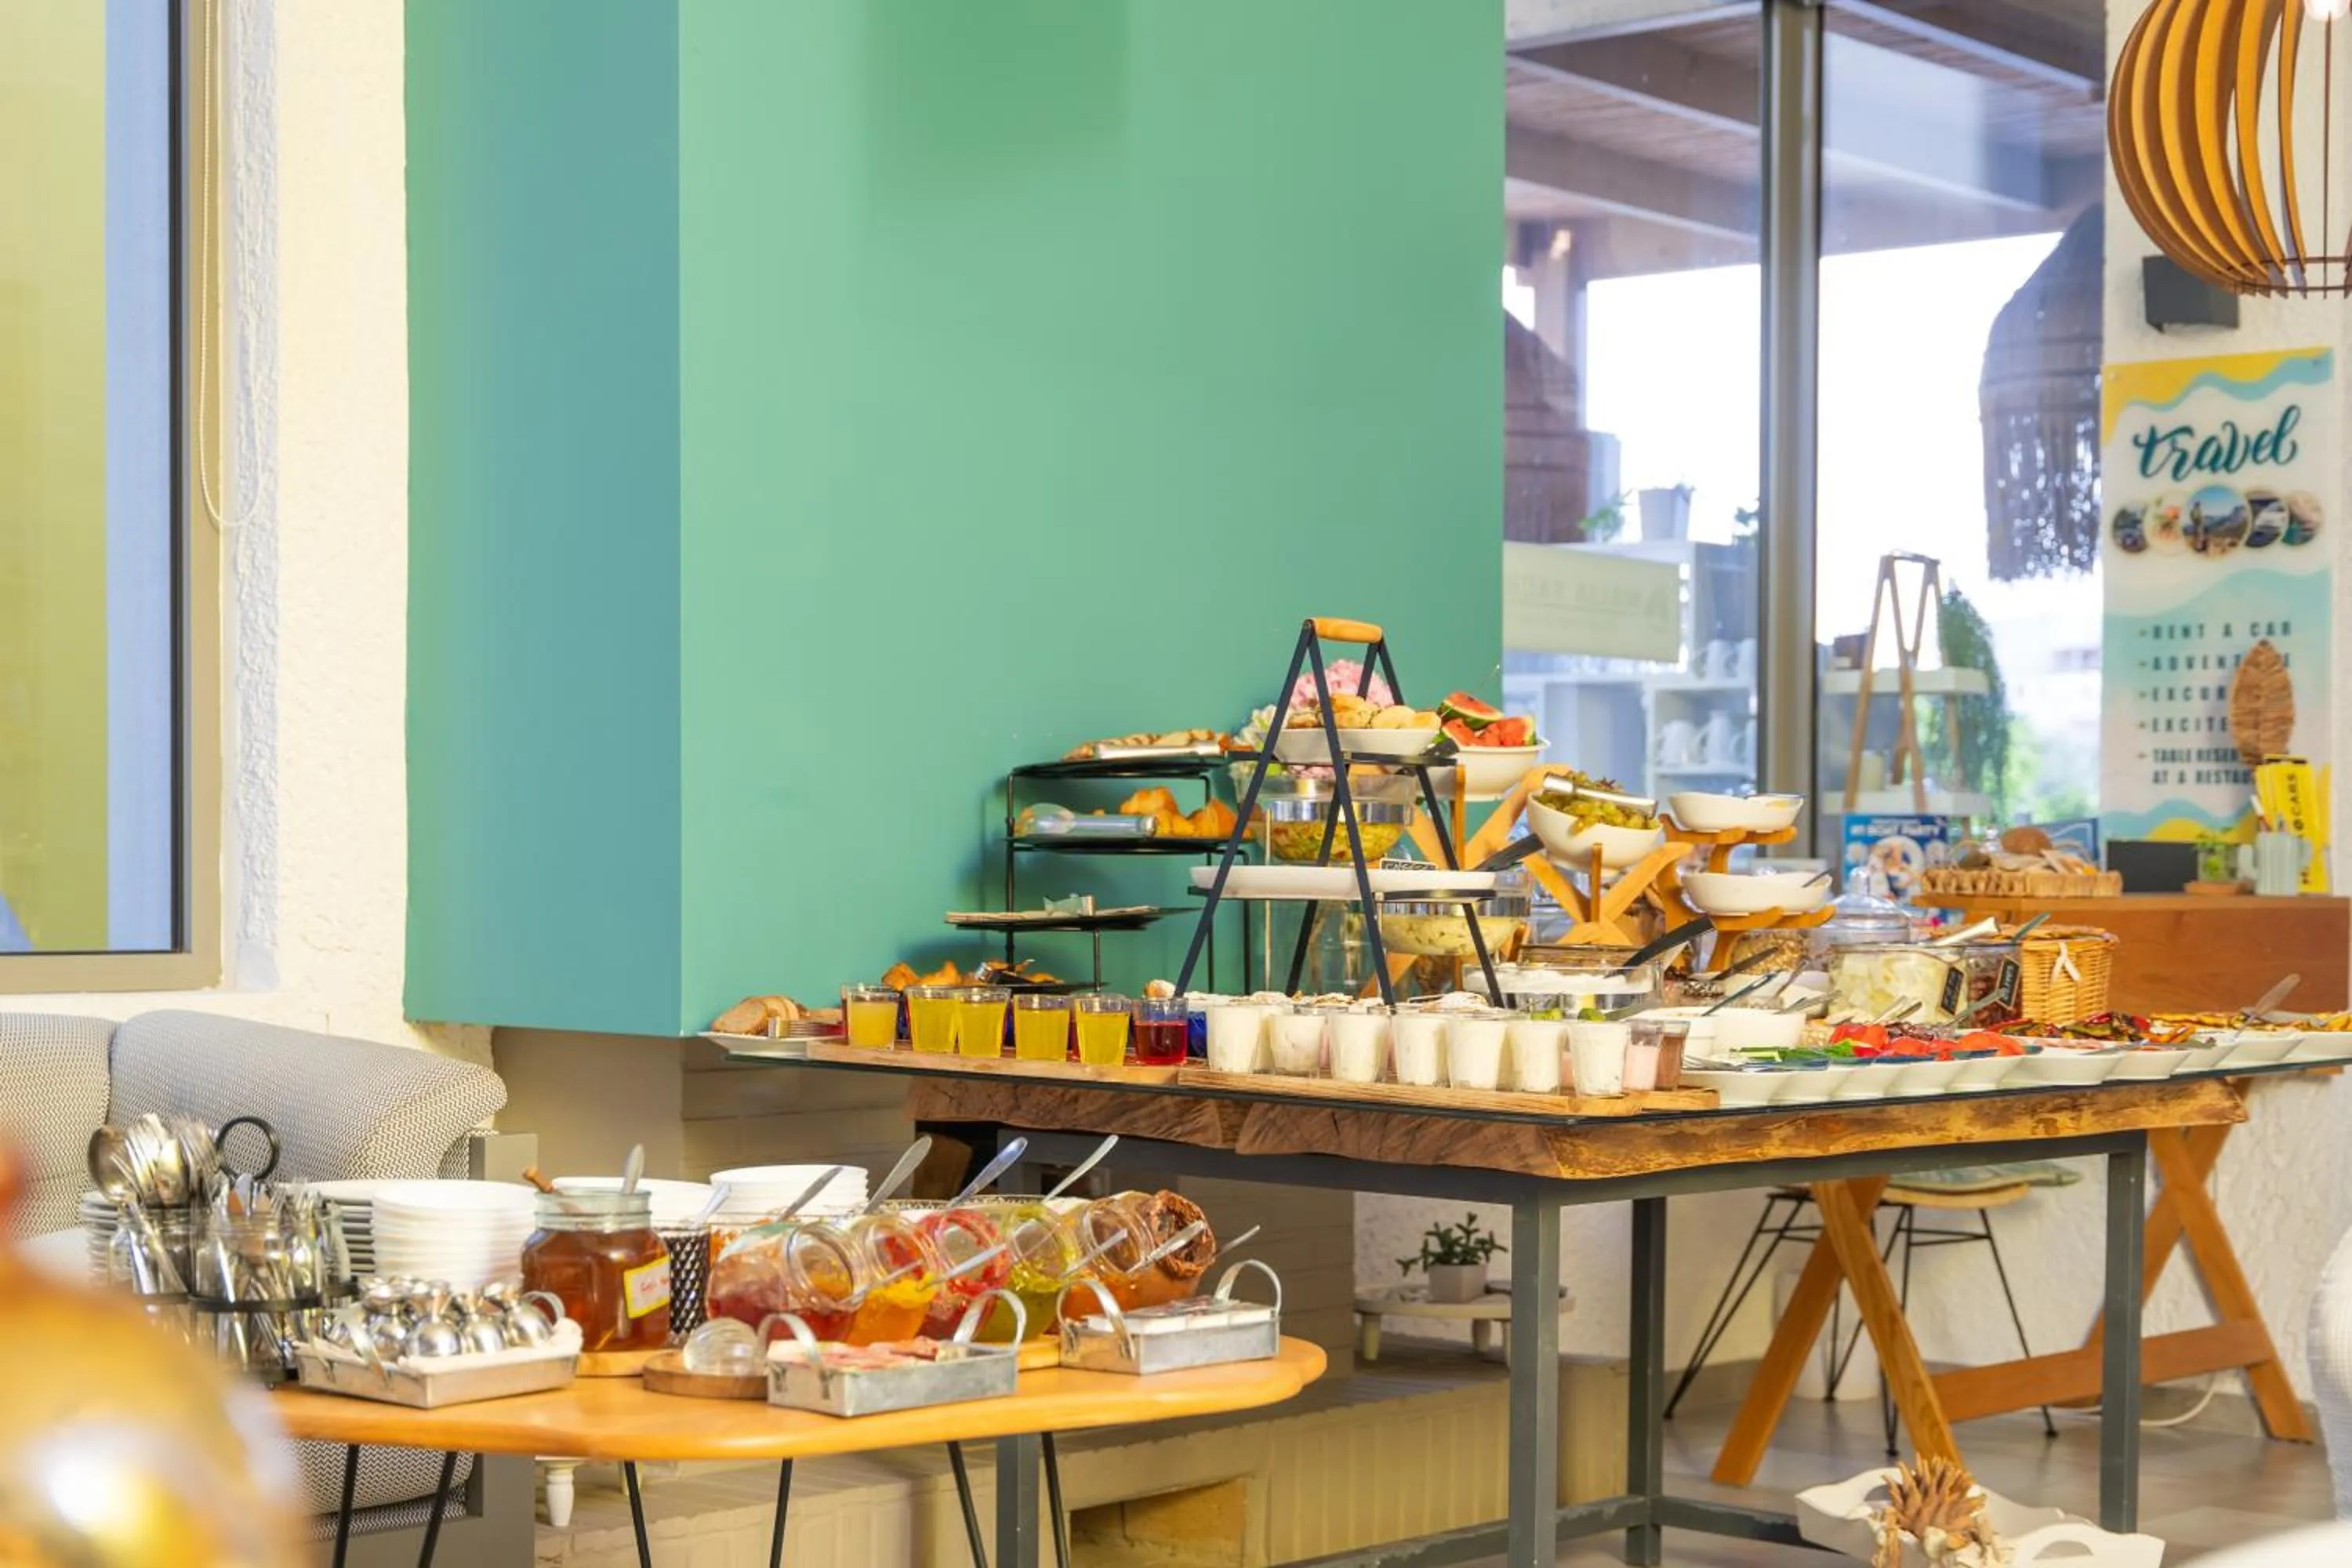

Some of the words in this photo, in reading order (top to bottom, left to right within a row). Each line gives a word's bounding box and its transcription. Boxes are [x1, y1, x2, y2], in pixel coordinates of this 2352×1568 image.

[2133, 405, 2301, 482] travel
[2153, 624, 2205, 640] RENT
[2223, 622, 2233, 637] A
[2250, 621, 2292, 637] CAR
[2153, 653, 2290, 671] ADVENTE
